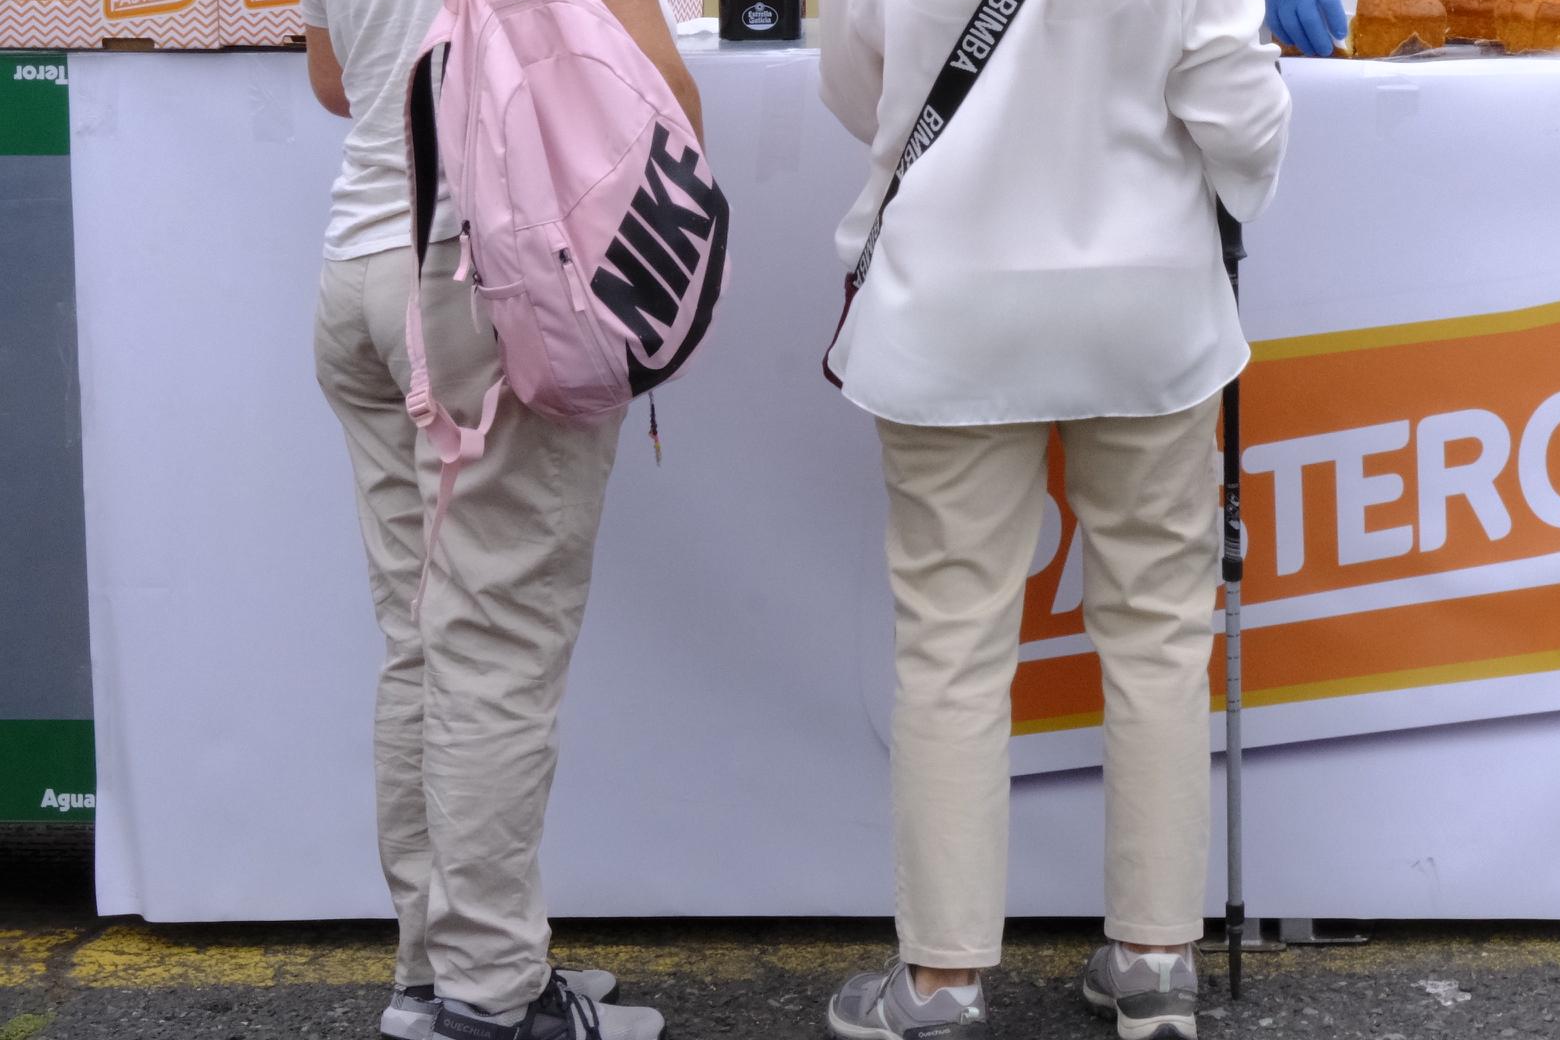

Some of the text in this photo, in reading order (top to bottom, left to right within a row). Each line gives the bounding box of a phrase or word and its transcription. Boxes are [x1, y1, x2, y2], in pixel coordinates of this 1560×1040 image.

[14, 64, 69, 86] Teror
[590, 121, 716, 358] NIKE
[41, 788, 96, 813] Agua
